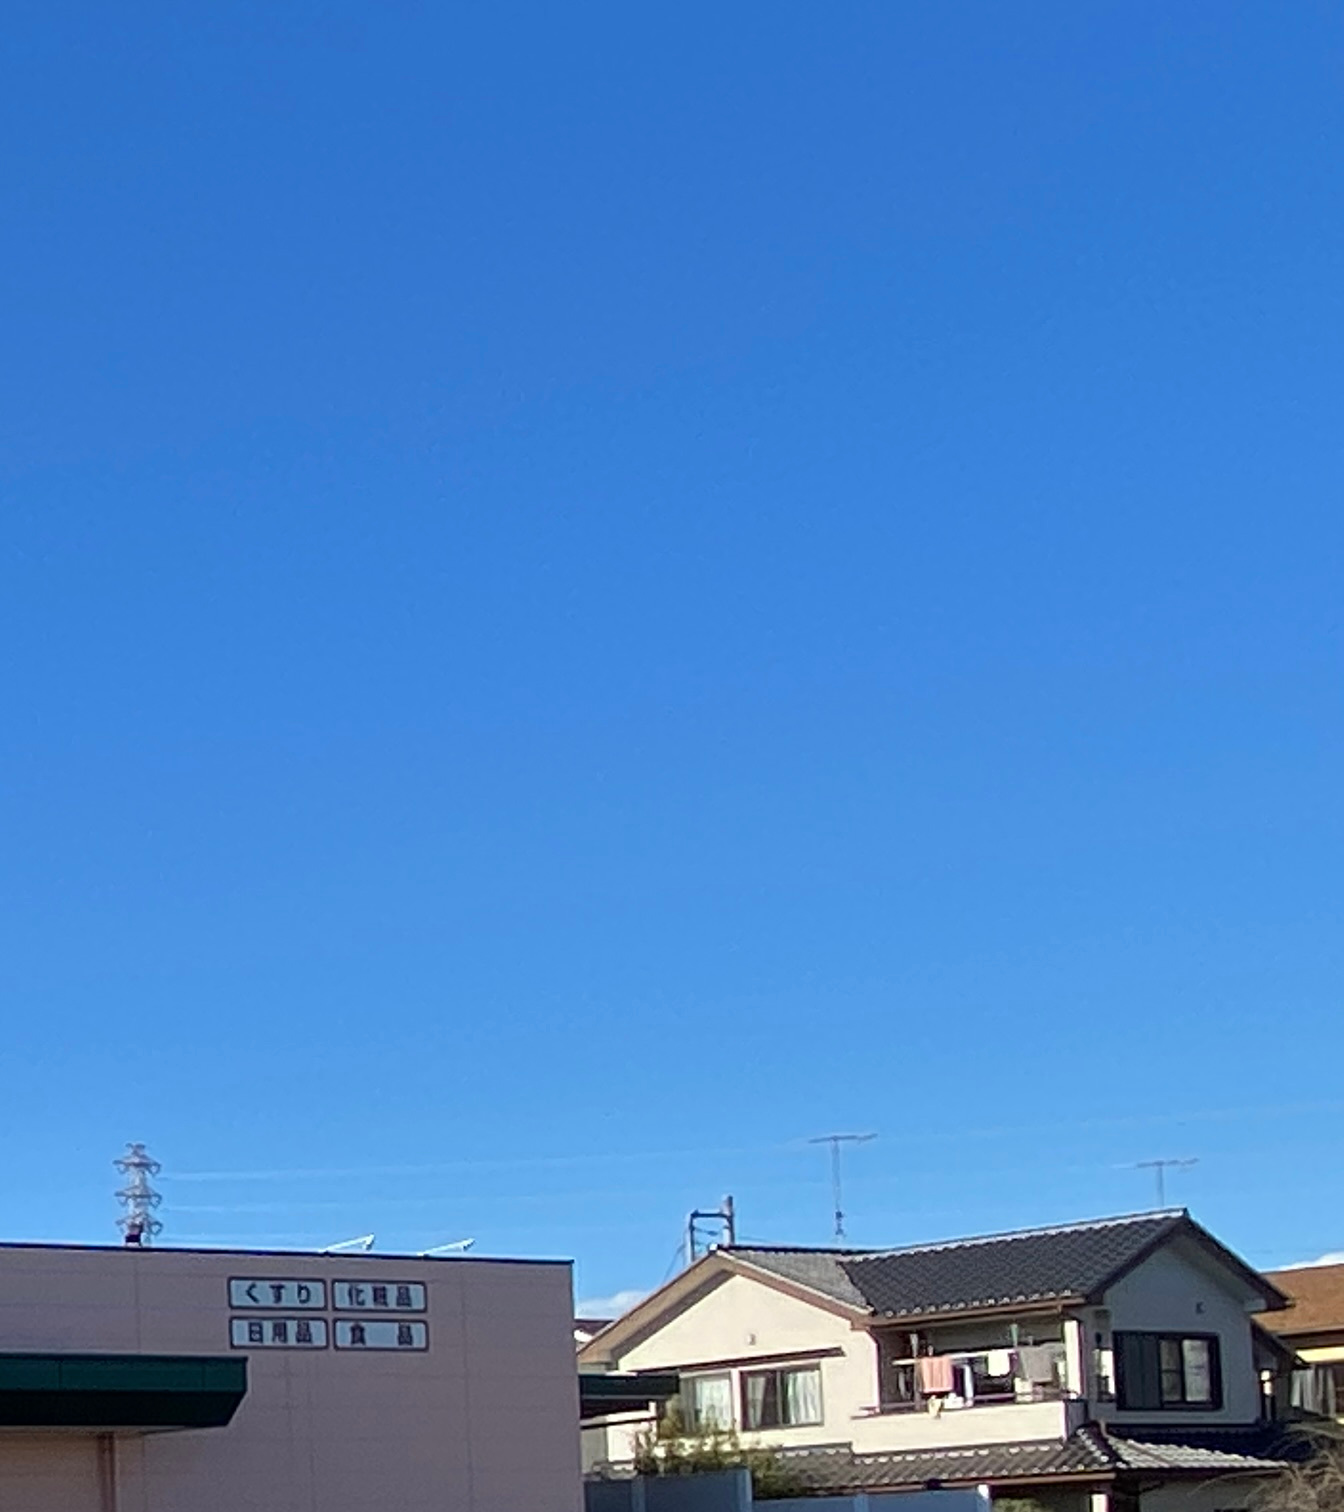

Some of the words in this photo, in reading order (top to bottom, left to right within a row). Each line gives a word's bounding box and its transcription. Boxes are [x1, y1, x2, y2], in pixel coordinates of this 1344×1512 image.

[245, 1283, 312, 1305] くすり
[347, 1285, 413, 1308] 化粧品
[247, 1320, 313, 1344] 日用品
